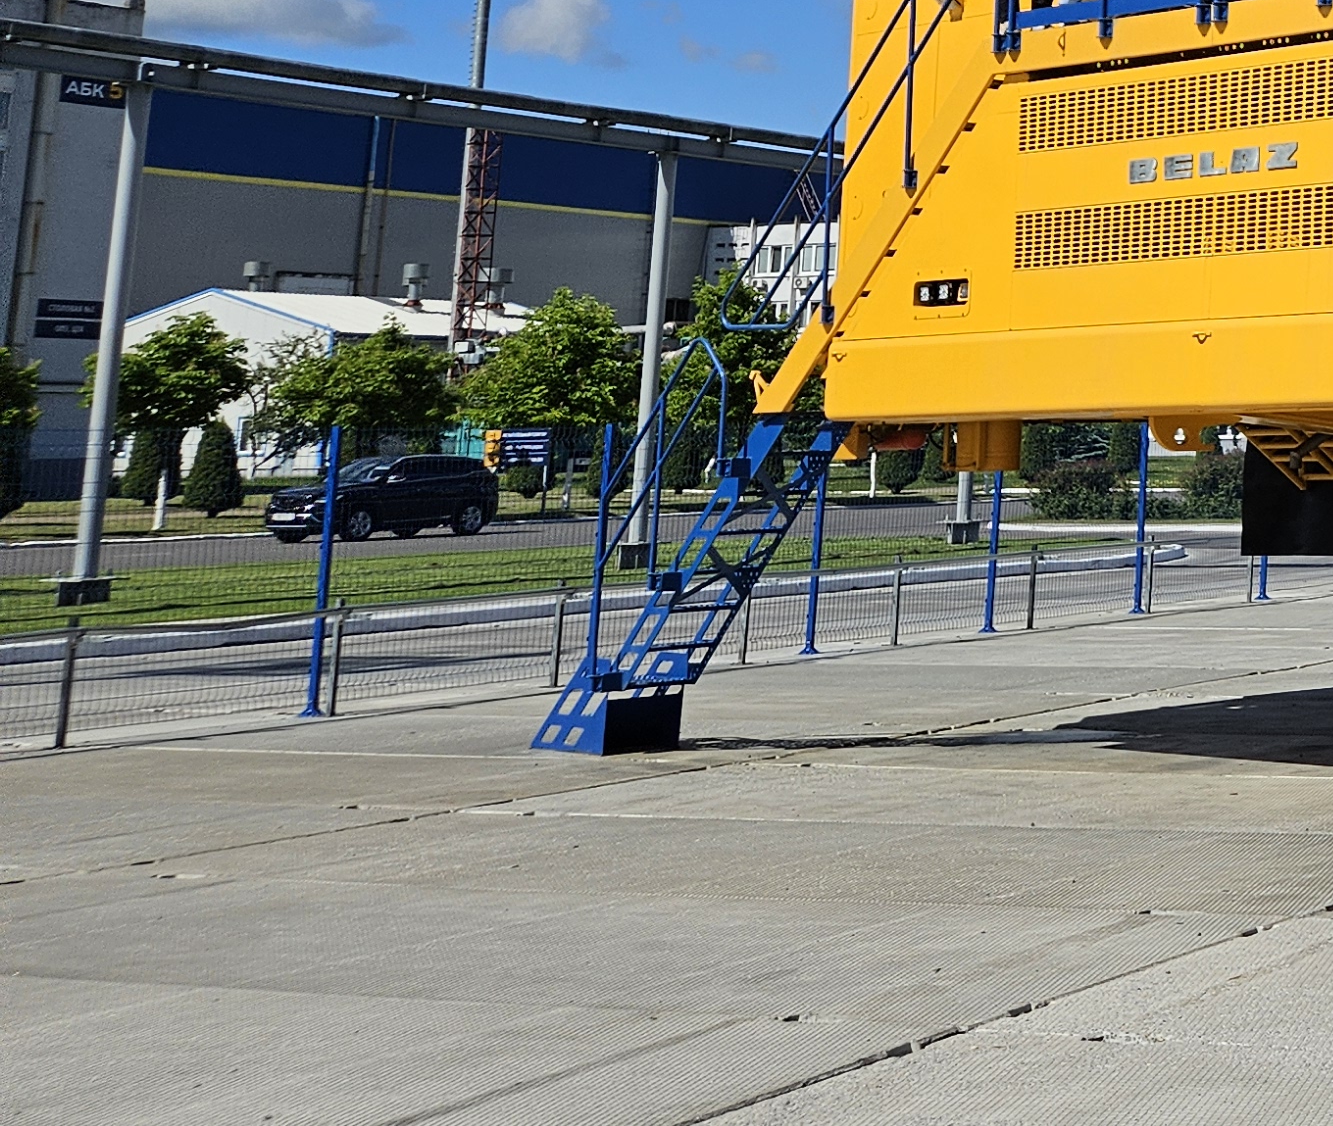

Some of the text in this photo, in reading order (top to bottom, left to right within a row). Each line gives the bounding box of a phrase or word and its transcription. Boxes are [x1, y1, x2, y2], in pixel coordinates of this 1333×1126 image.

[65, 80, 124, 99] АБК 5
[1129, 141, 1299, 185] BELAZ
